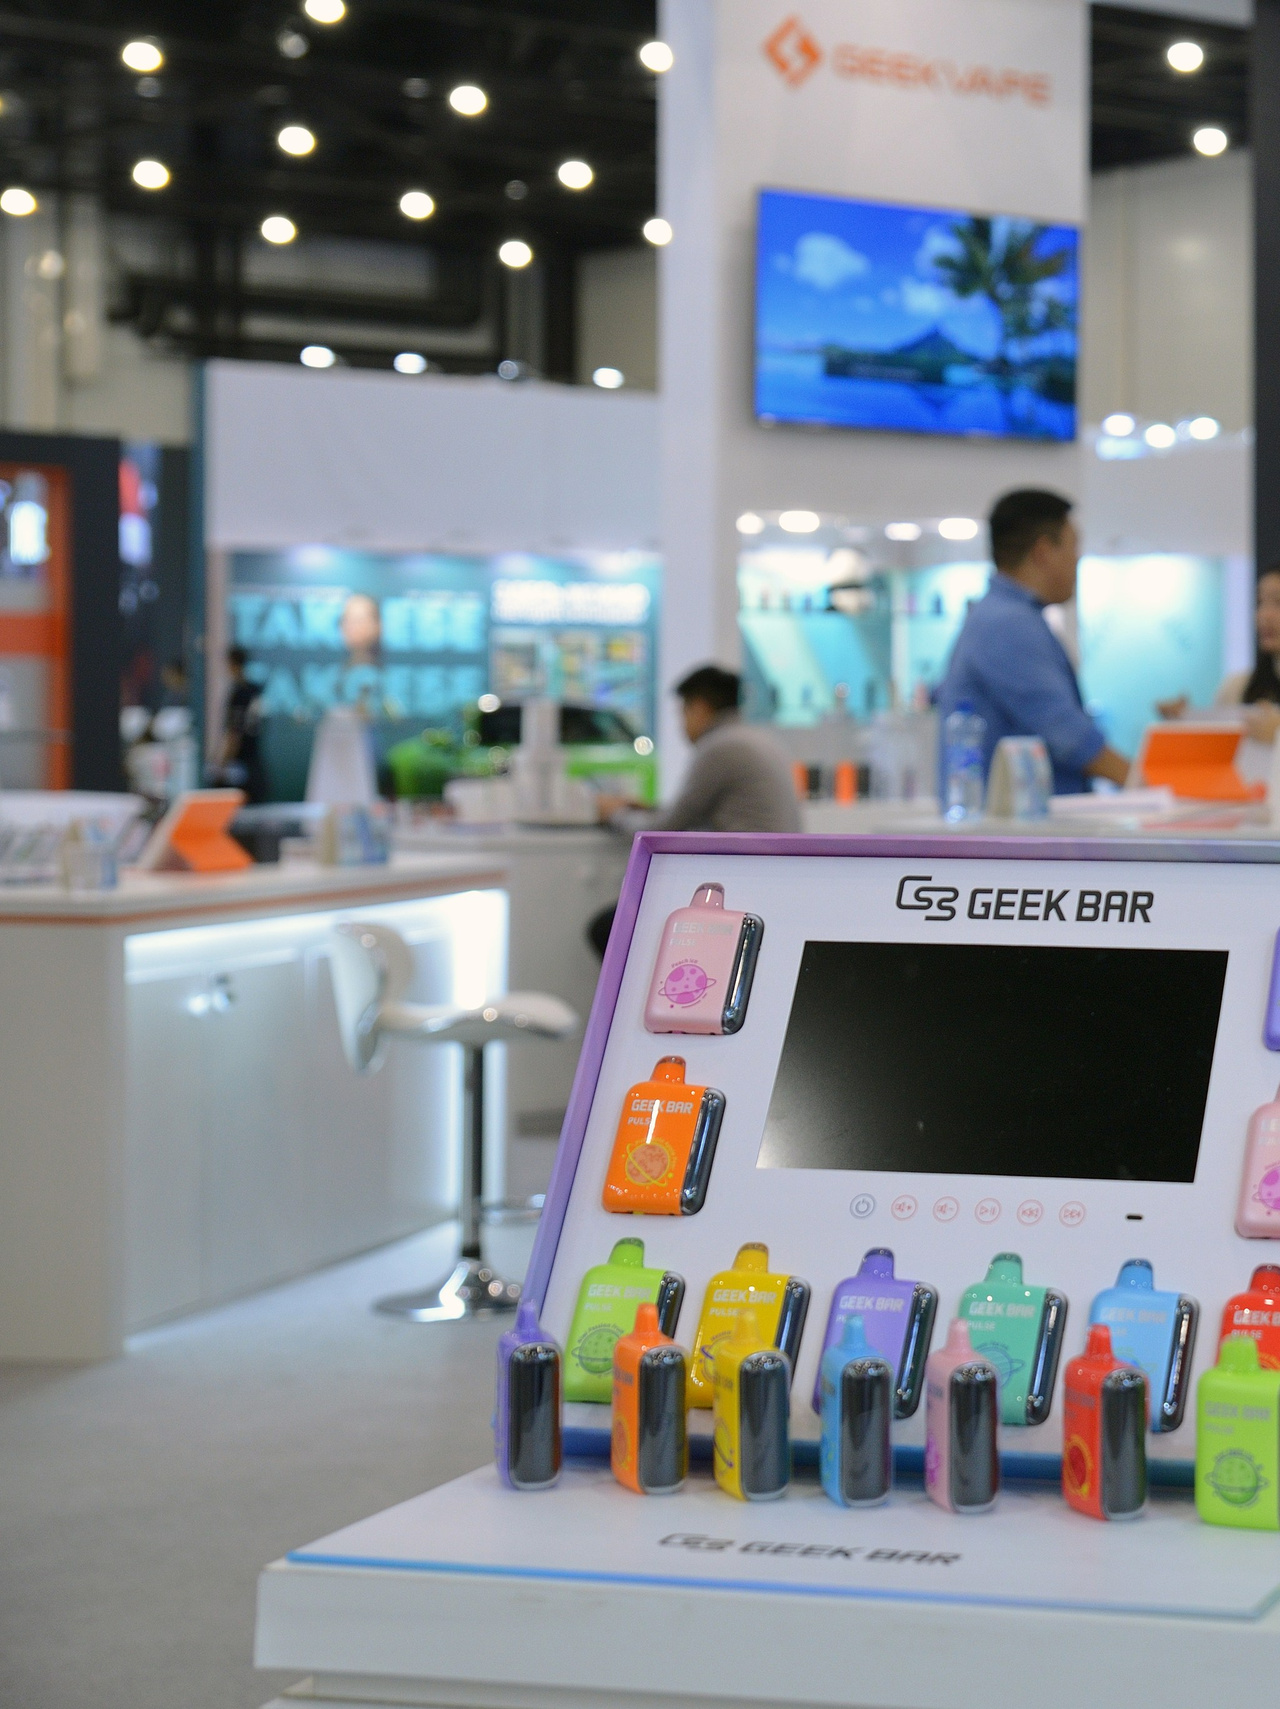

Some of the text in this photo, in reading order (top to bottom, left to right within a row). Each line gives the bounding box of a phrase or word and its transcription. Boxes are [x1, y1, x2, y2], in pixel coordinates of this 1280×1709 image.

[967, 888, 1154, 923] GEEK BAR
[666, 1100, 693, 1114] BAR
[713, 1288, 747, 1303] GEEK
[738, 1540, 964, 1567] GEEK BAR
